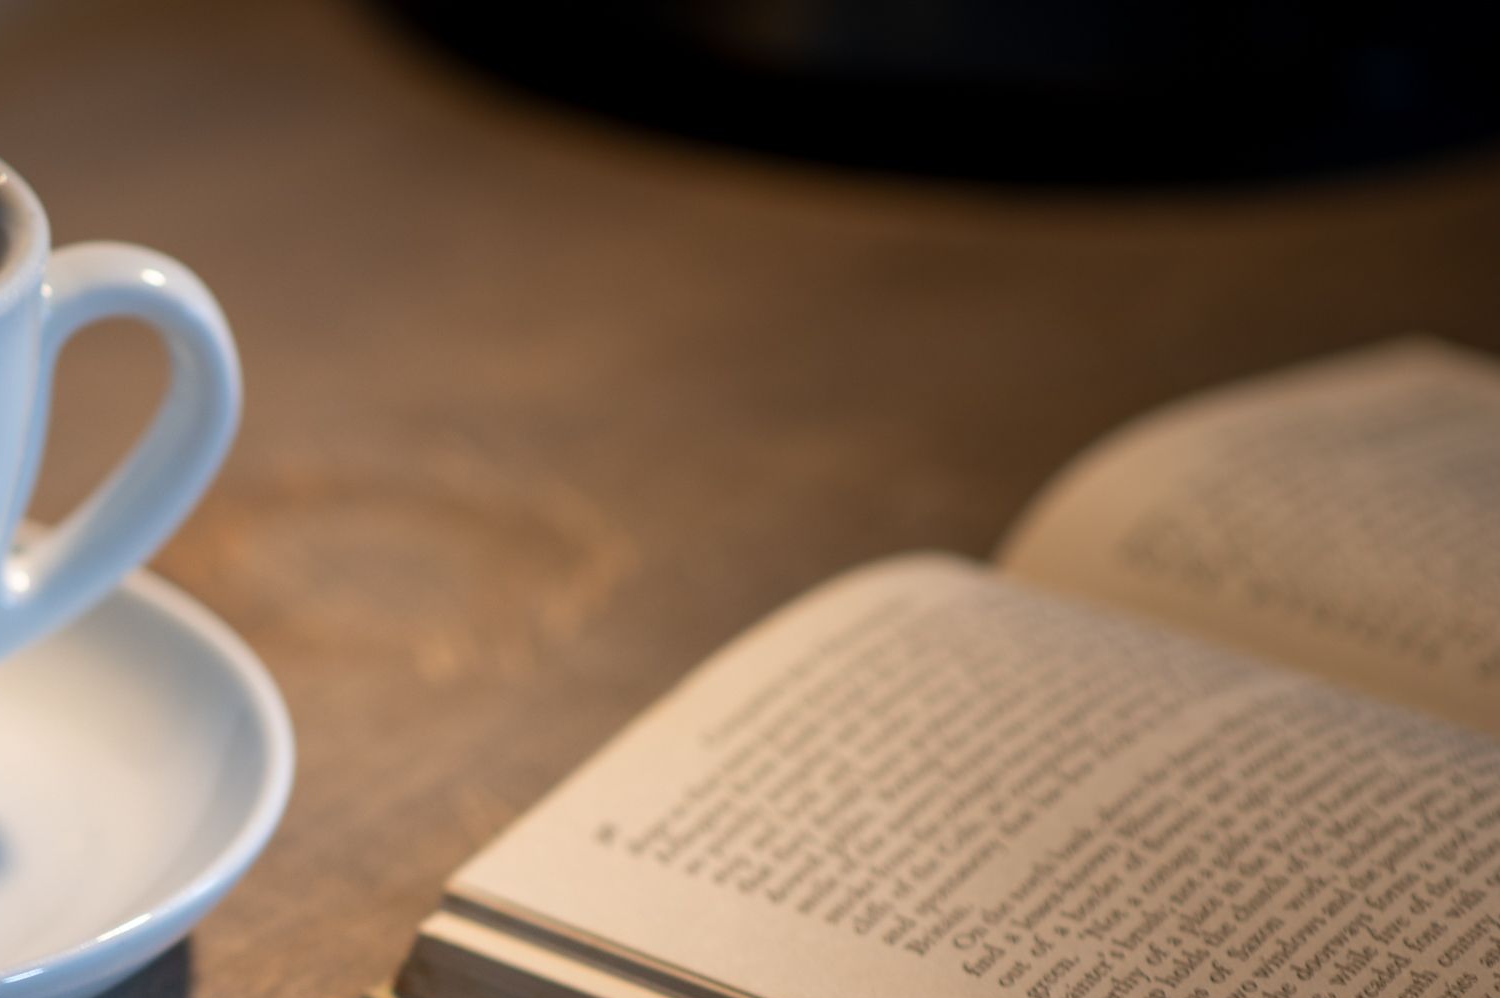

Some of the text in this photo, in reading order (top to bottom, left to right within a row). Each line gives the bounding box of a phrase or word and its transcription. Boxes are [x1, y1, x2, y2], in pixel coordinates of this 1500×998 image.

[997, 960, 1030, 988] out
[1029, 932, 1053, 957] of
[1144, 941, 1168, 966] of
[1153, 948, 1210, 989] holds
[1208, 958, 1232, 984] of
[1328, 945, 1378, 986] while
